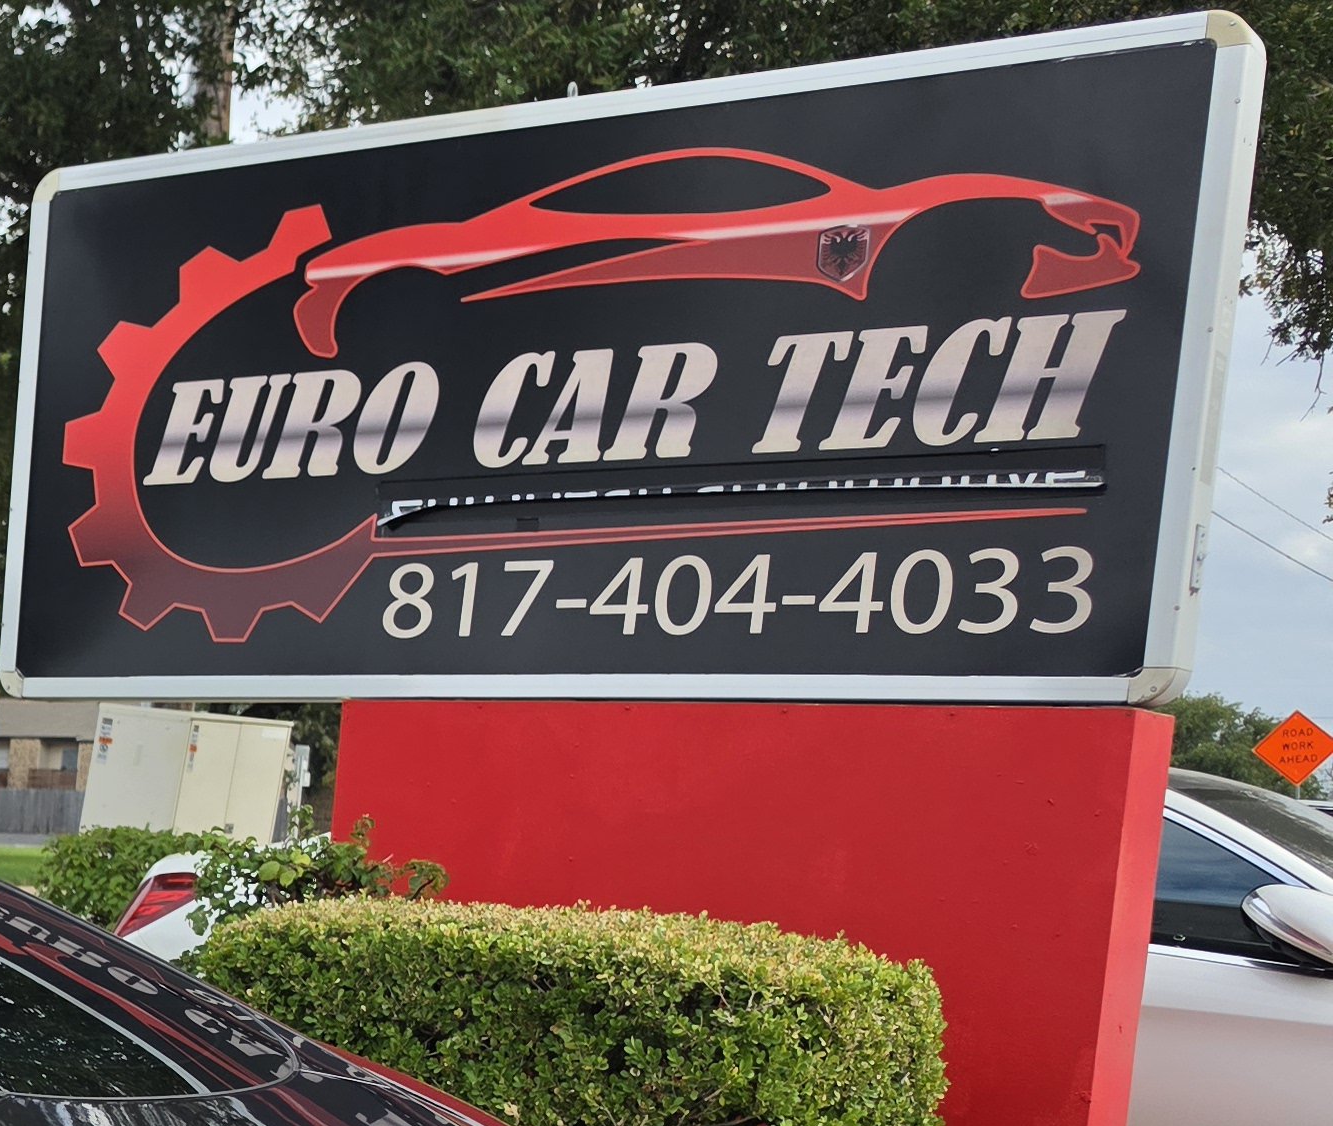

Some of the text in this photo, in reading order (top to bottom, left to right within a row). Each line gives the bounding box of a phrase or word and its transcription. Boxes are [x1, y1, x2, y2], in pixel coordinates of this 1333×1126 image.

[142, 308, 1128, 486] EURO CAR TECH
[381, 545, 1094, 638] 817-404-4033
[1282, 727, 1314, 738] ROAD
[1282, 740, 1314, 751] WORK
[1279, 754, 1319, 764] AHEAD
